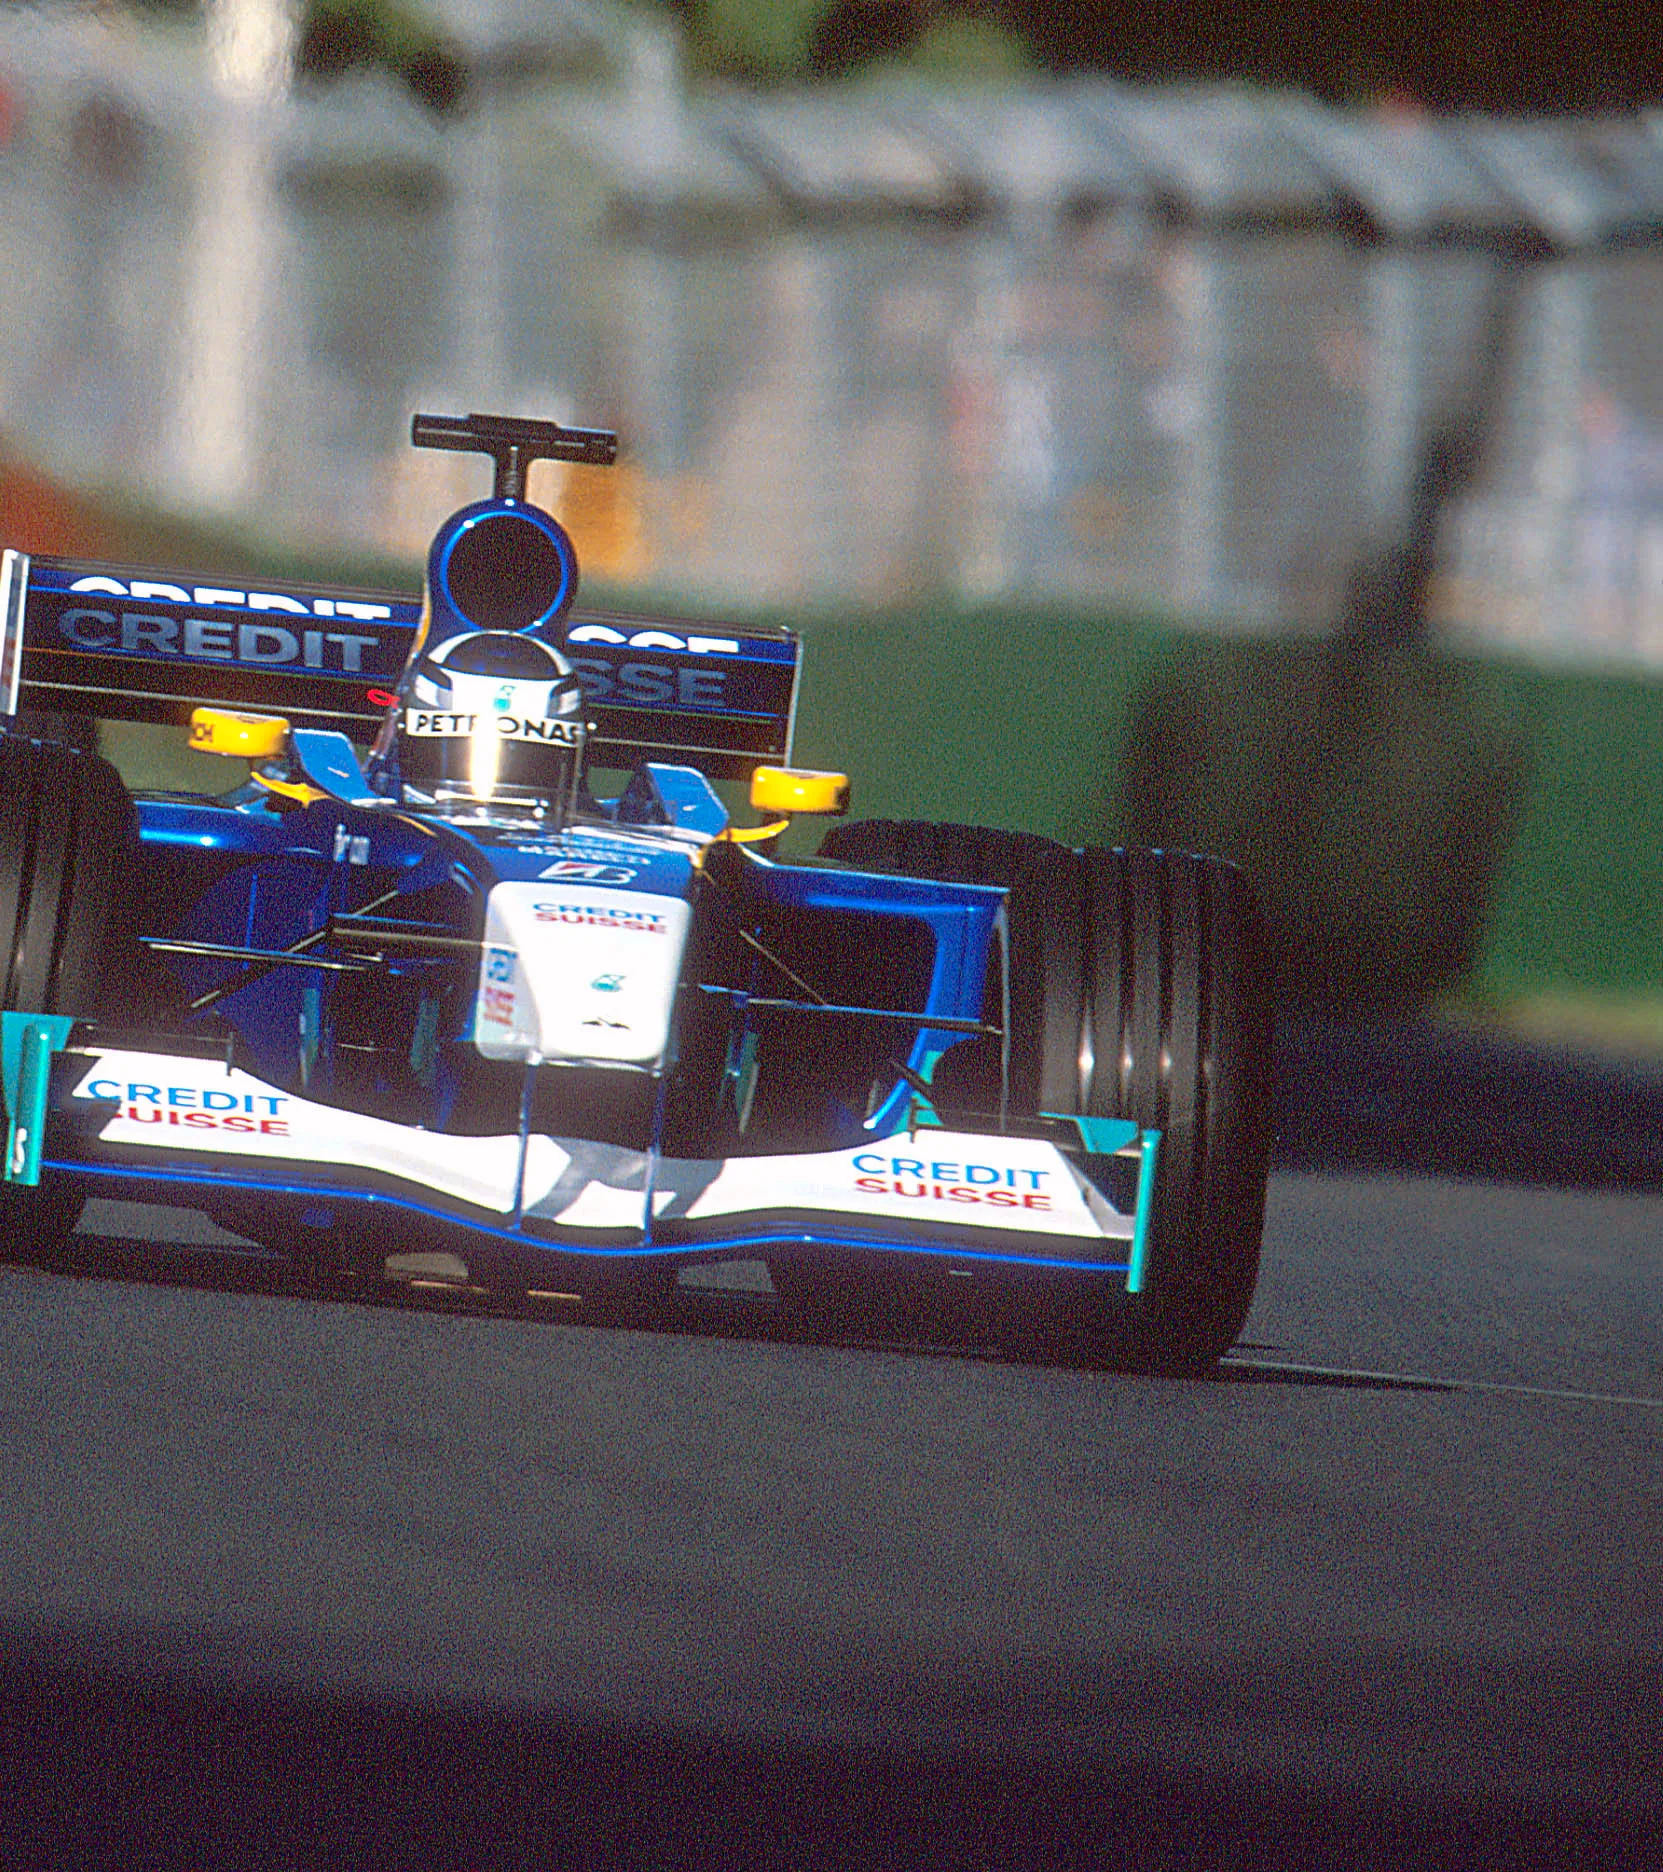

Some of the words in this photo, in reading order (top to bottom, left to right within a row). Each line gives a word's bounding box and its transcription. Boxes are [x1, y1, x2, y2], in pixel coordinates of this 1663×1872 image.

[58, 607, 379, 672] CREDIT
[532, 902, 666, 923] CREDIT
[535, 912, 668, 935] SUISSE
[88, 1079, 289, 1116] CREDIT
[852, 1154, 1051, 1190] CREDIT
[855, 1177, 1054, 1212] SUISSE
